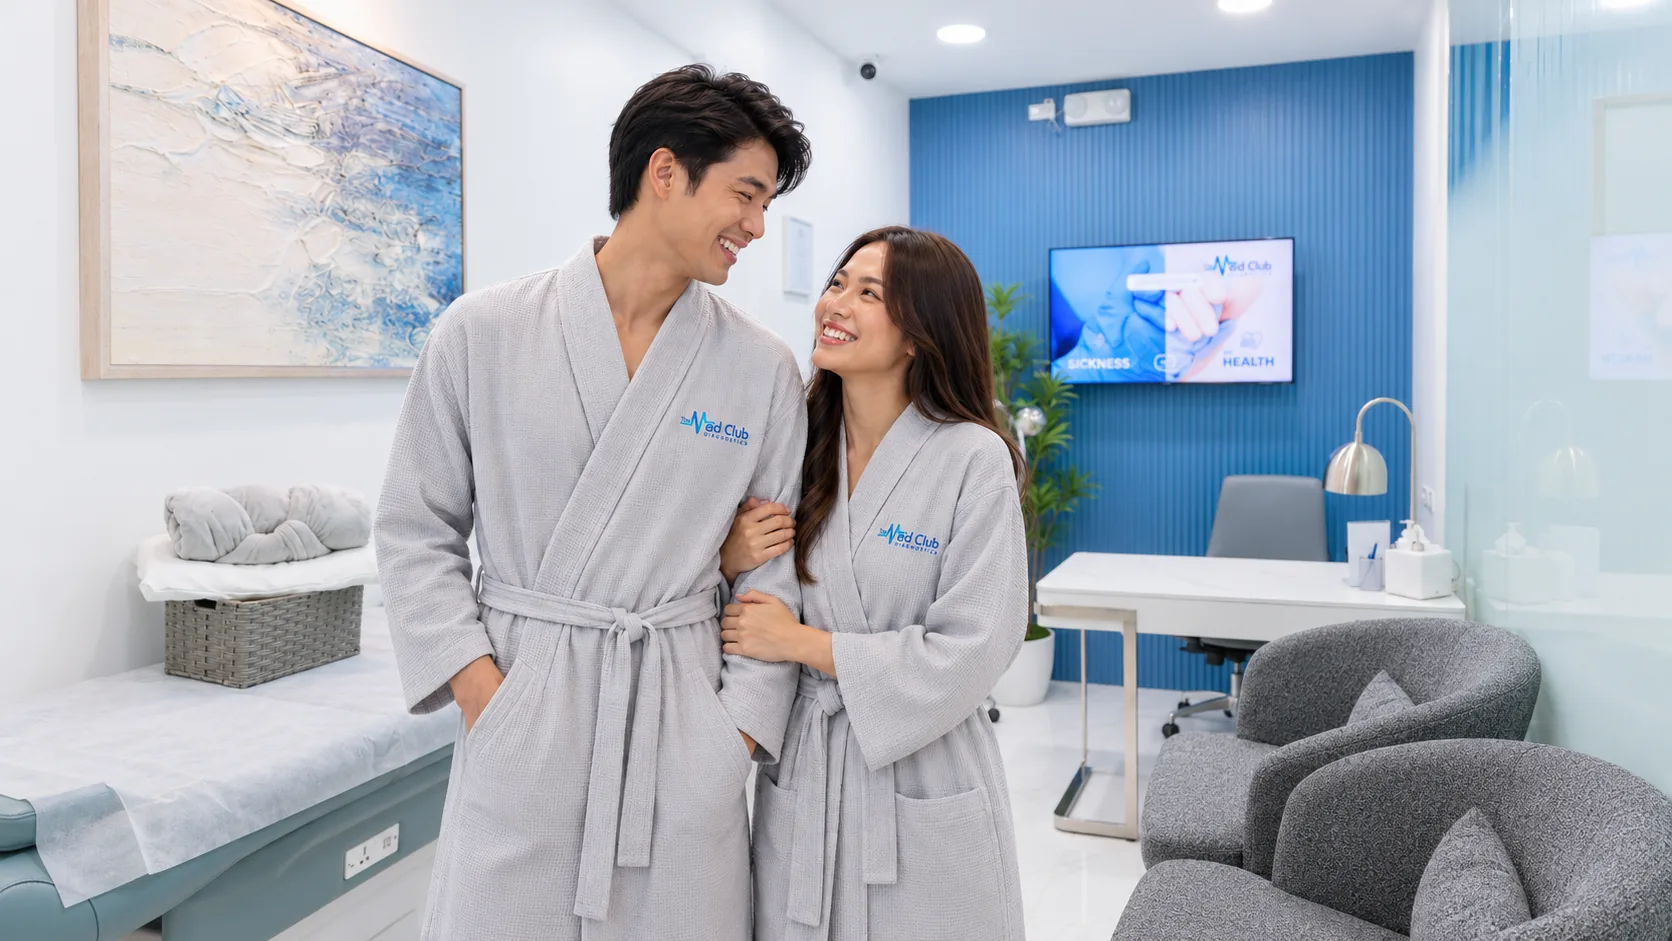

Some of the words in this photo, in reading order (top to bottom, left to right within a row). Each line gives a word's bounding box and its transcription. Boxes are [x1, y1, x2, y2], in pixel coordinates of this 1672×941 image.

[1247, 260, 1273, 272] Club
[1067, 357, 1131, 370] SICKNESS
[1223, 356, 1275, 367] HEALTH
[690, 410, 723, 434] Med
[724, 423, 750, 440] Club
[886, 523, 914, 545] Med
[914, 533, 940, 549] Club
